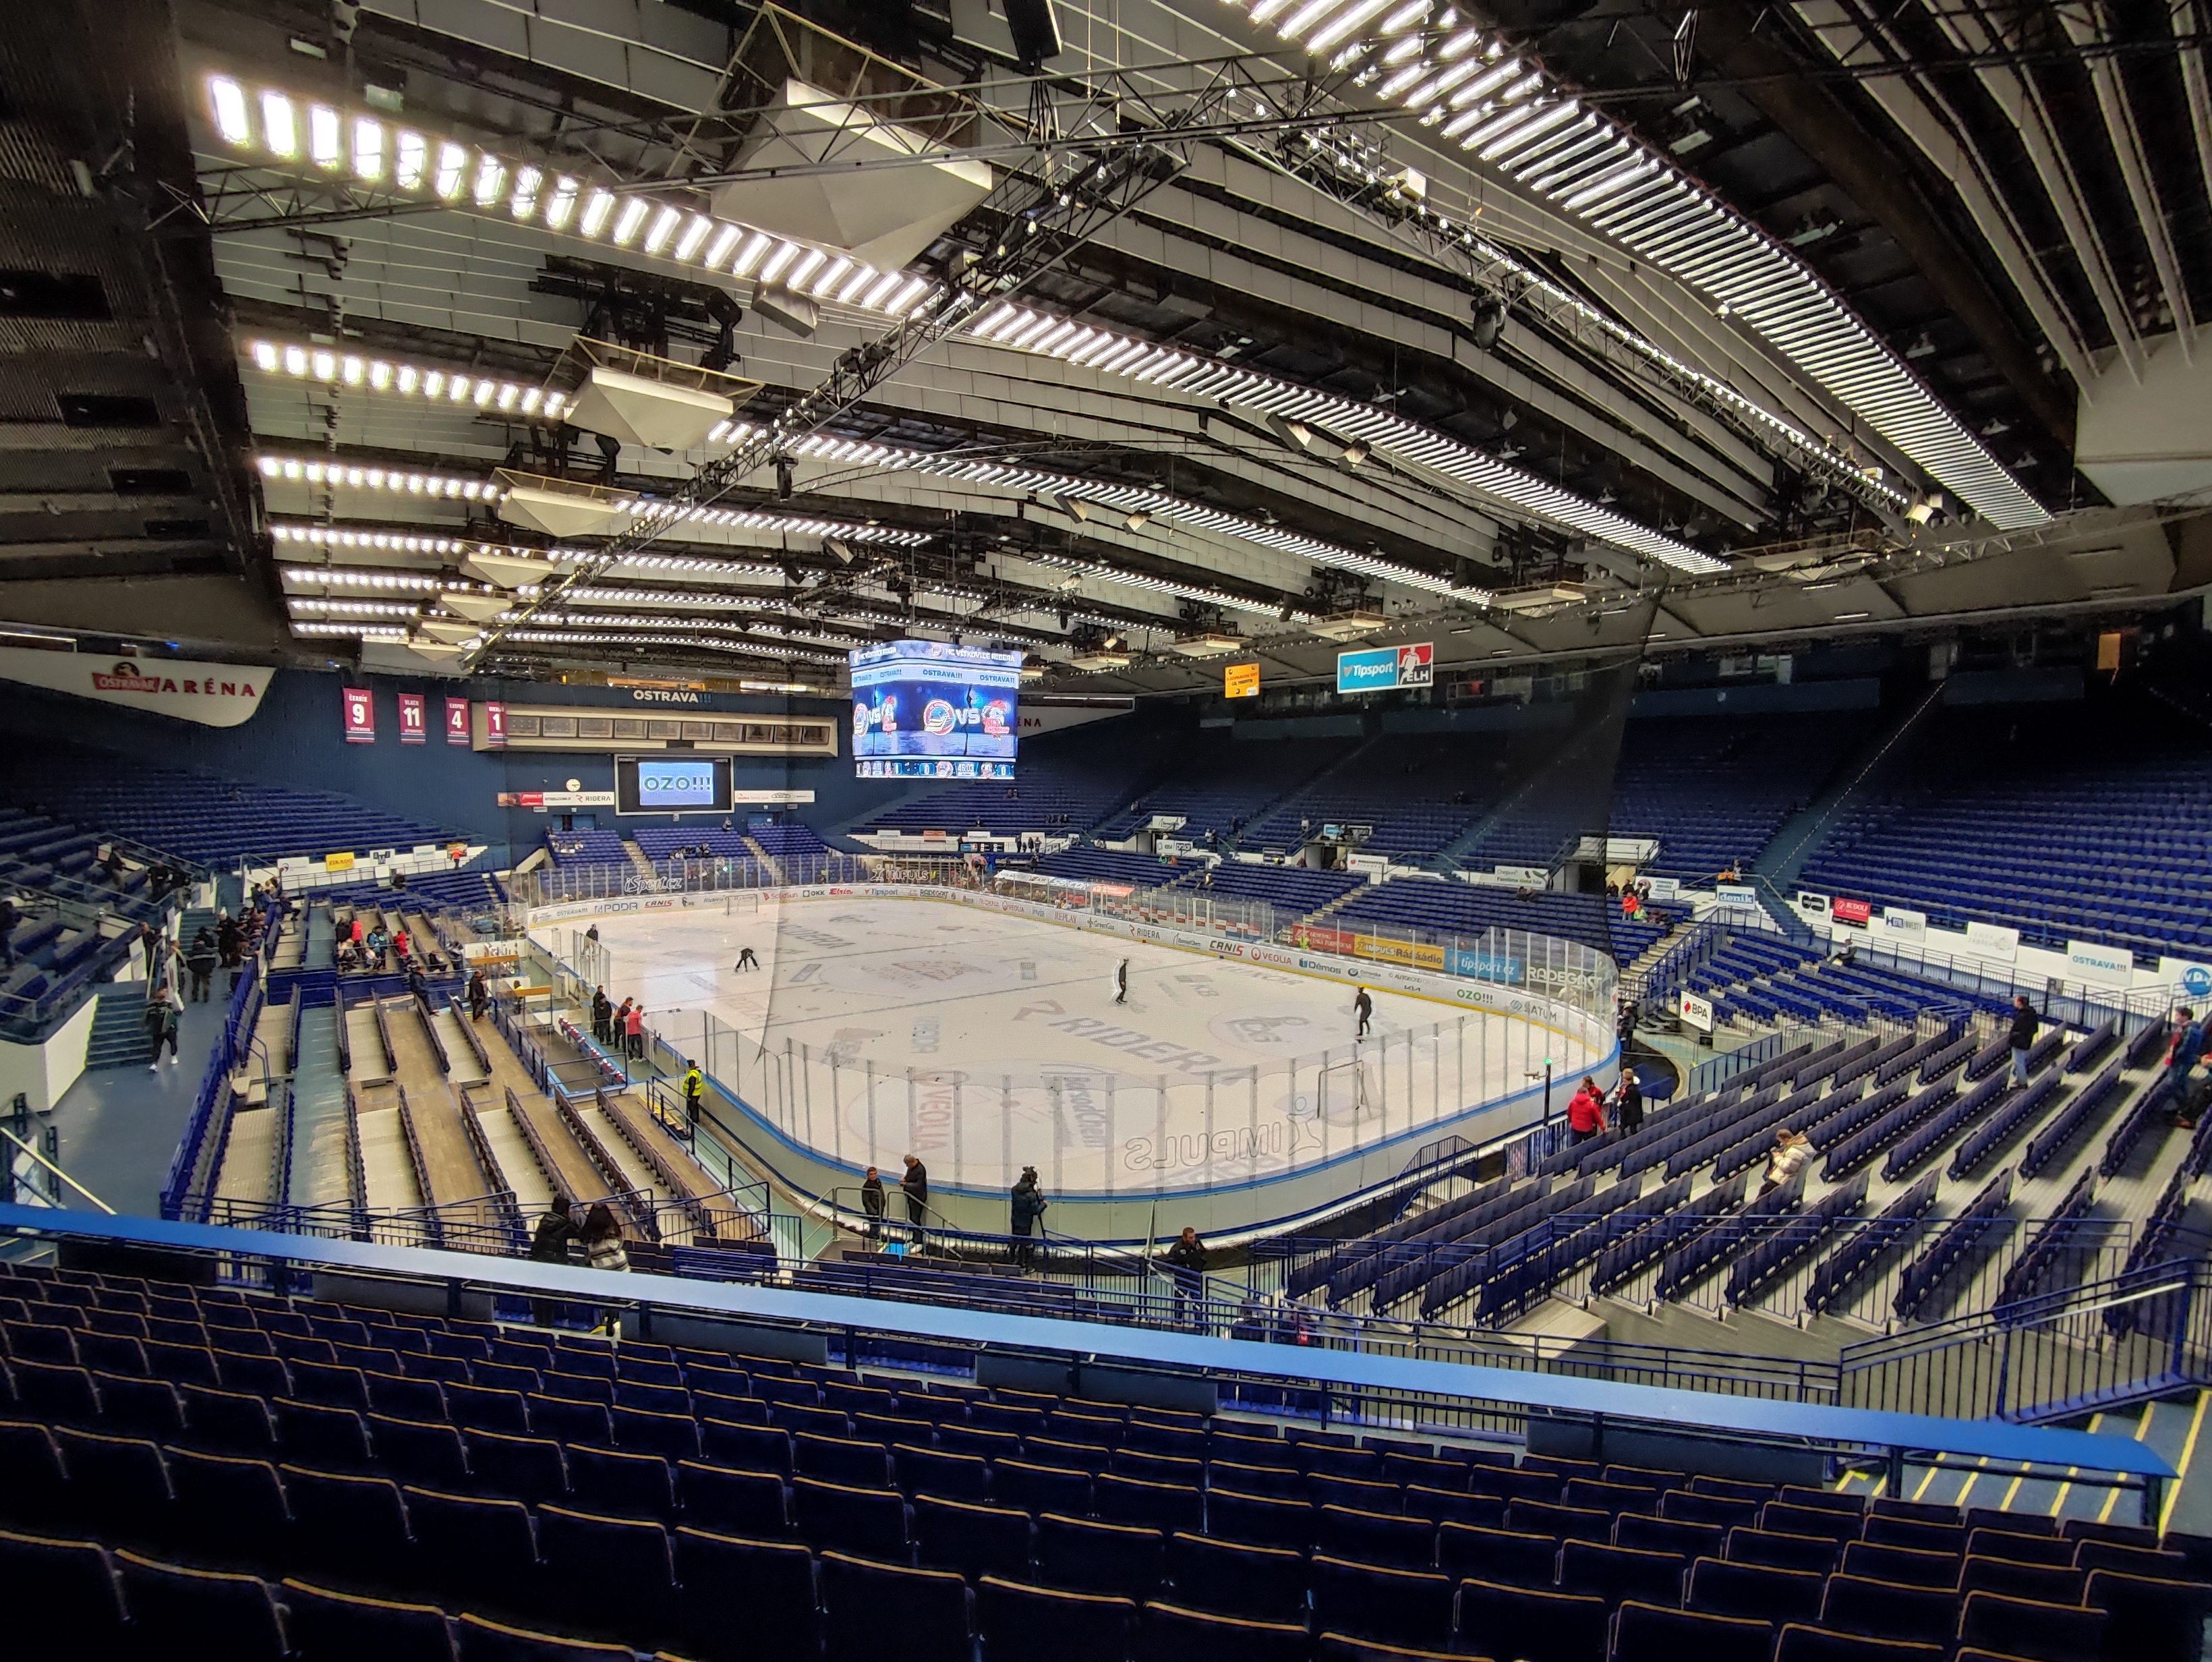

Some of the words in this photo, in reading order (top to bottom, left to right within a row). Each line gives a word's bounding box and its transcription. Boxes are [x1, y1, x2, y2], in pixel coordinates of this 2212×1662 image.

[1354, 661, 1394, 679] Tipsport
[1407, 670, 1429, 682] ELH
[161, 677, 256, 697] ARÉNA
[633, 689, 712, 704] OSTRAVA!!!
[353, 704, 365, 724] 9
[403, 707, 420, 727] 11
[451, 710, 463, 728] 4
[492, 713, 500, 730] 1
[955, 708, 981, 724] VS
[643, 776, 711, 791] OZO!!!
[624, 875, 683, 893] iSport.cz
[885, 868, 930, 882] IMPULS
[606, 902, 638, 913] PODA
[645, 899, 674, 908] CANIS
[1137, 927, 1161, 940] RIDERA
[1209, 940, 1245, 956] CANIS
[1262, 952, 1293, 965] VEOLIA
[1365, 943, 1395, 956] IMPULS
[2072, 954, 2127, 973] OSTRAVA!!!
[1404, 984, 1421, 992] KIA
[1530, 965, 1602, 993] RADEGAST
[1457, 987, 1494, 1004] OZO!!!
[1691, 1002, 1708, 1020] BPA
